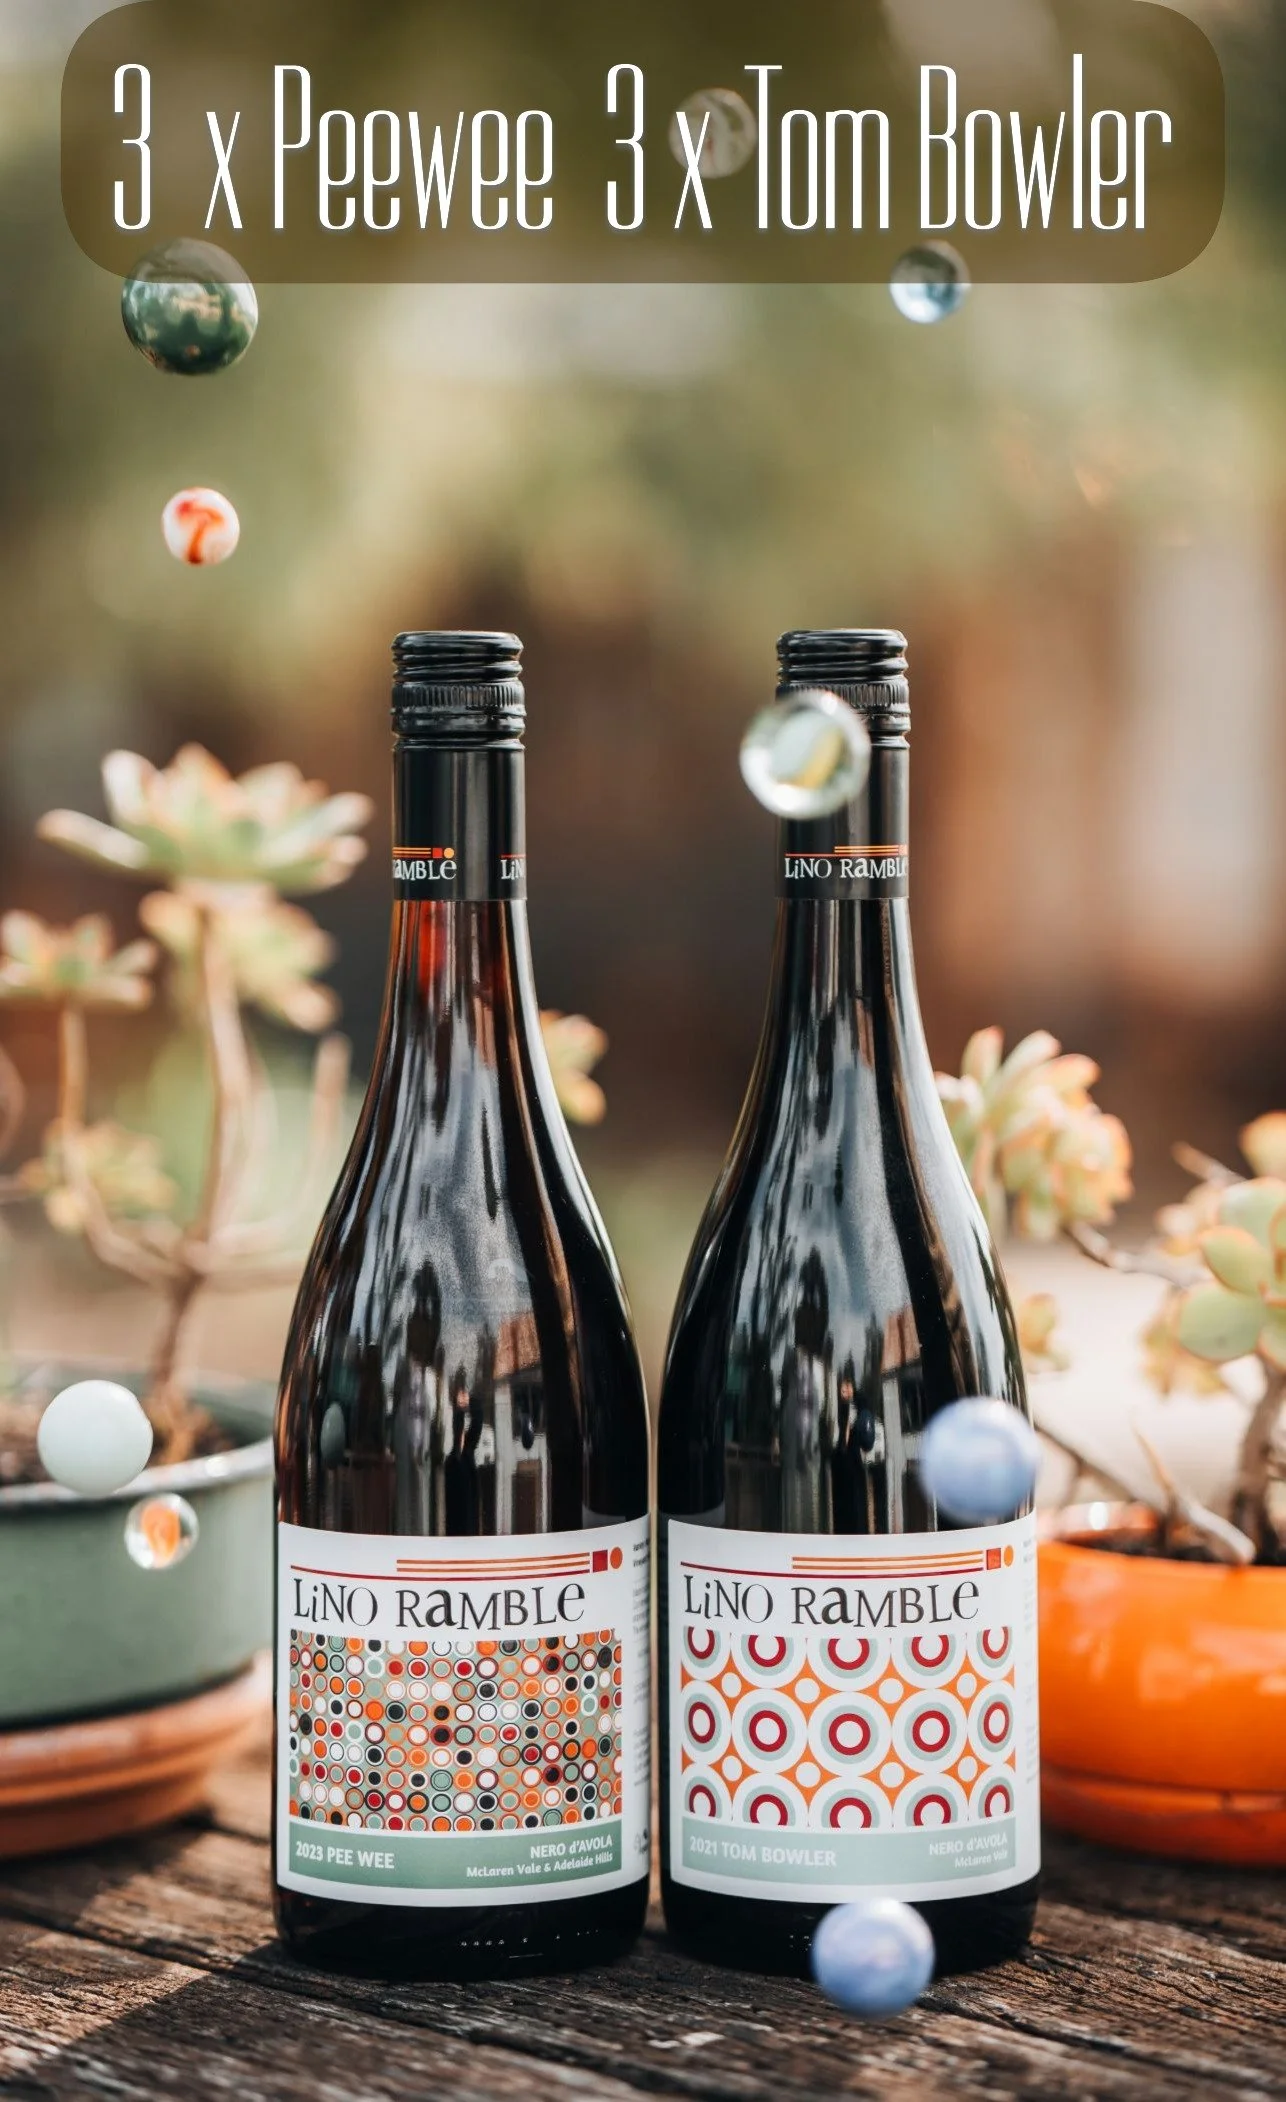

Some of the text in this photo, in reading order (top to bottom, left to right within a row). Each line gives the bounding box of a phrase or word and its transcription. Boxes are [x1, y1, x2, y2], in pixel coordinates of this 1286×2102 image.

[392, 859, 457, 881] aMBLe
[500, 858, 526, 880] LiN
[296, 1841, 395, 1869] 2023 PEE WEE
[530, 1843, 566, 1859] NERO
[569, 1834, 613, 1853] d'AVOLA
[689, 1836, 837, 1867] 2021 TOM BOWLER
[929, 1840, 963, 1855] NERO
[466, 1851, 613, 1878] McLaren Vale & Adelaide Hills
